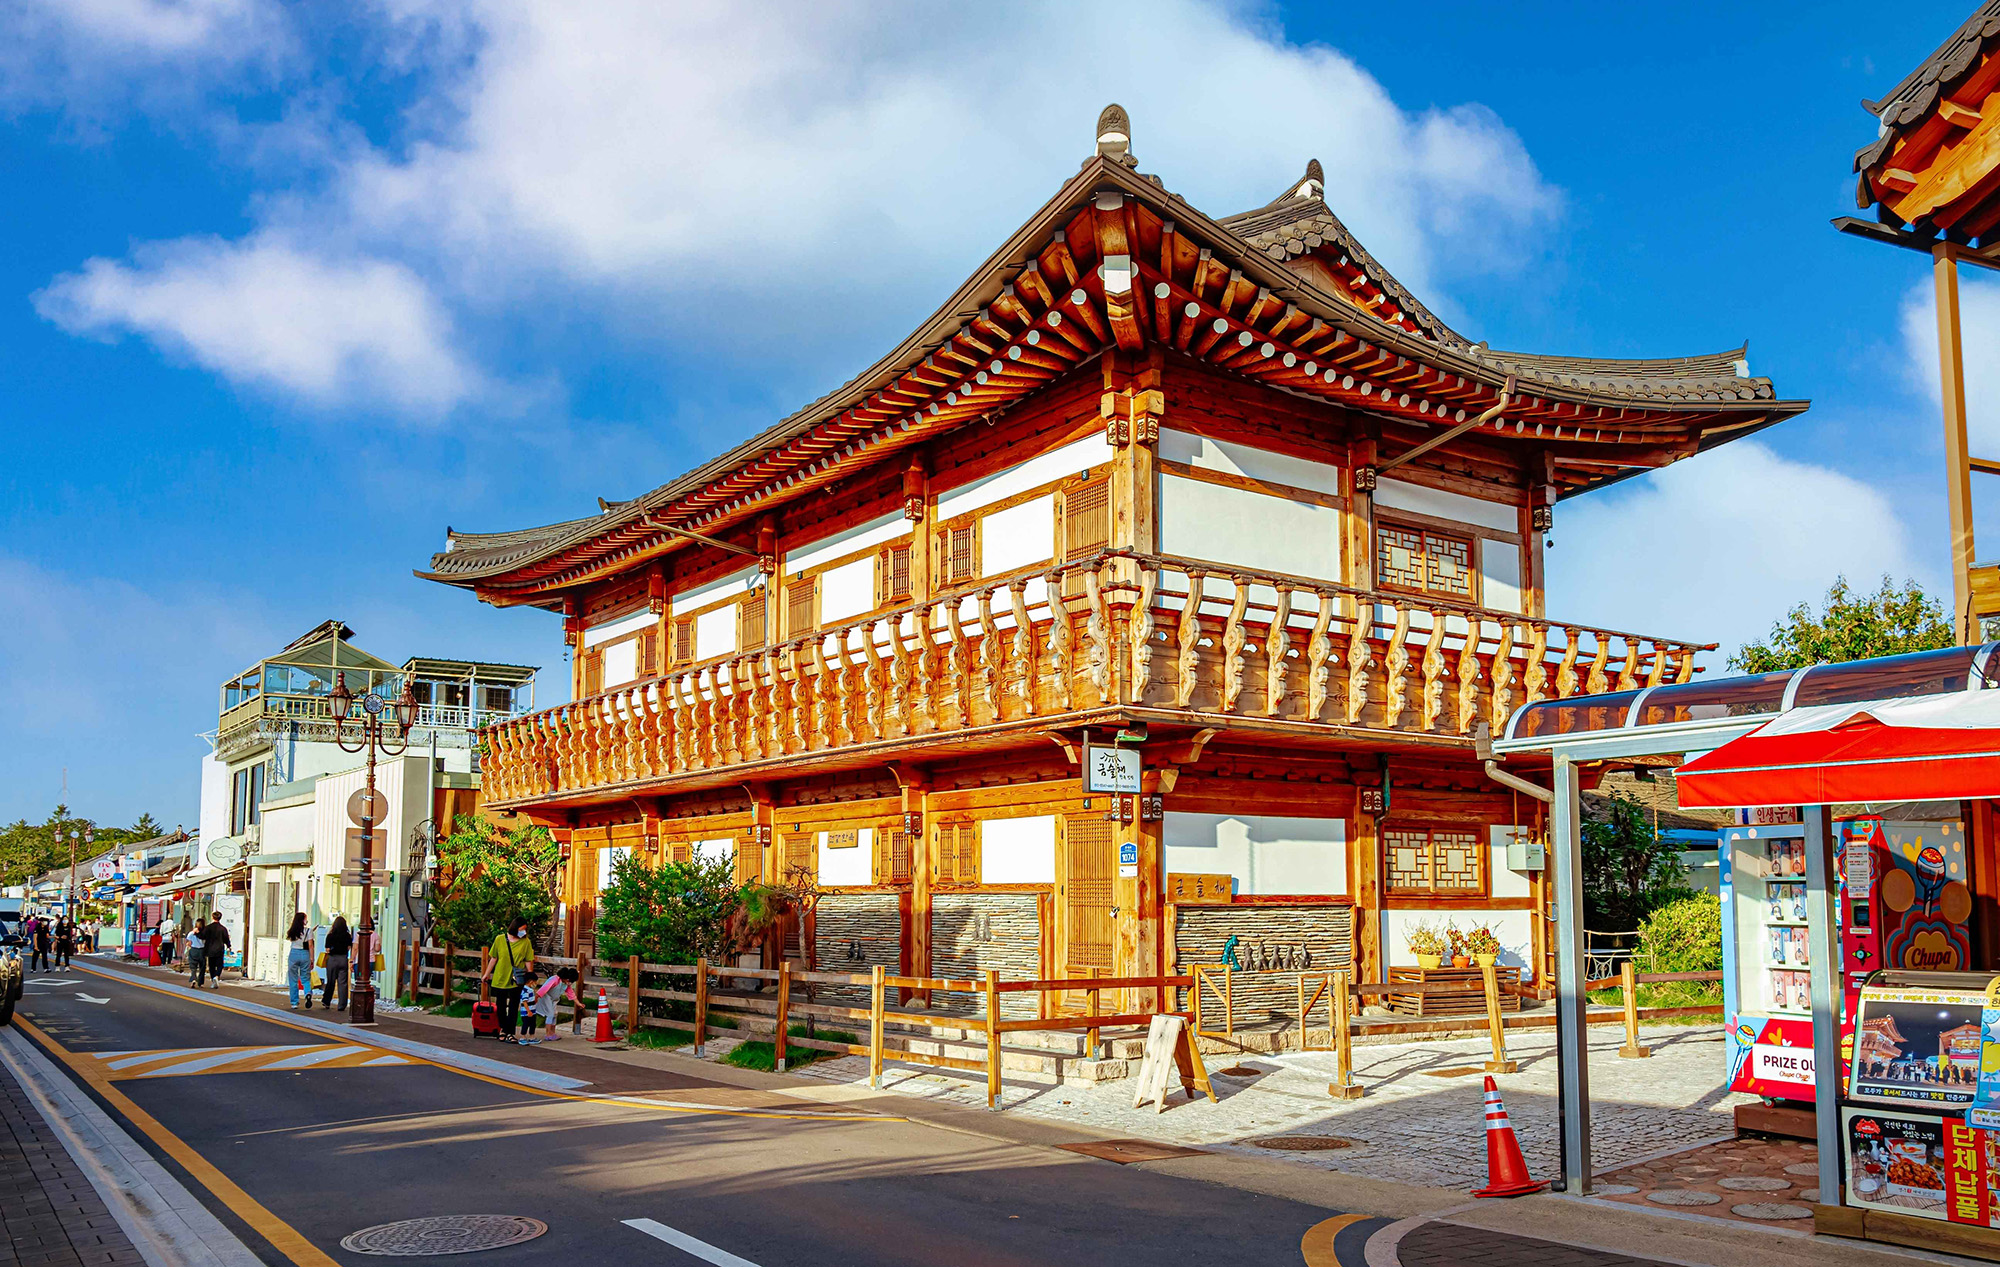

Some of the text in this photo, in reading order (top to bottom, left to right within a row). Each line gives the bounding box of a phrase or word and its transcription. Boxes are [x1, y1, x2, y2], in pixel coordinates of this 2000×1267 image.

[1121, 853, 1135, 862] 1074
[1911, 948, 1952, 969] Chupa
[1763, 1055, 1798, 1069] PRIZE
[1951, 1124, 1981, 1220] 단체납품
